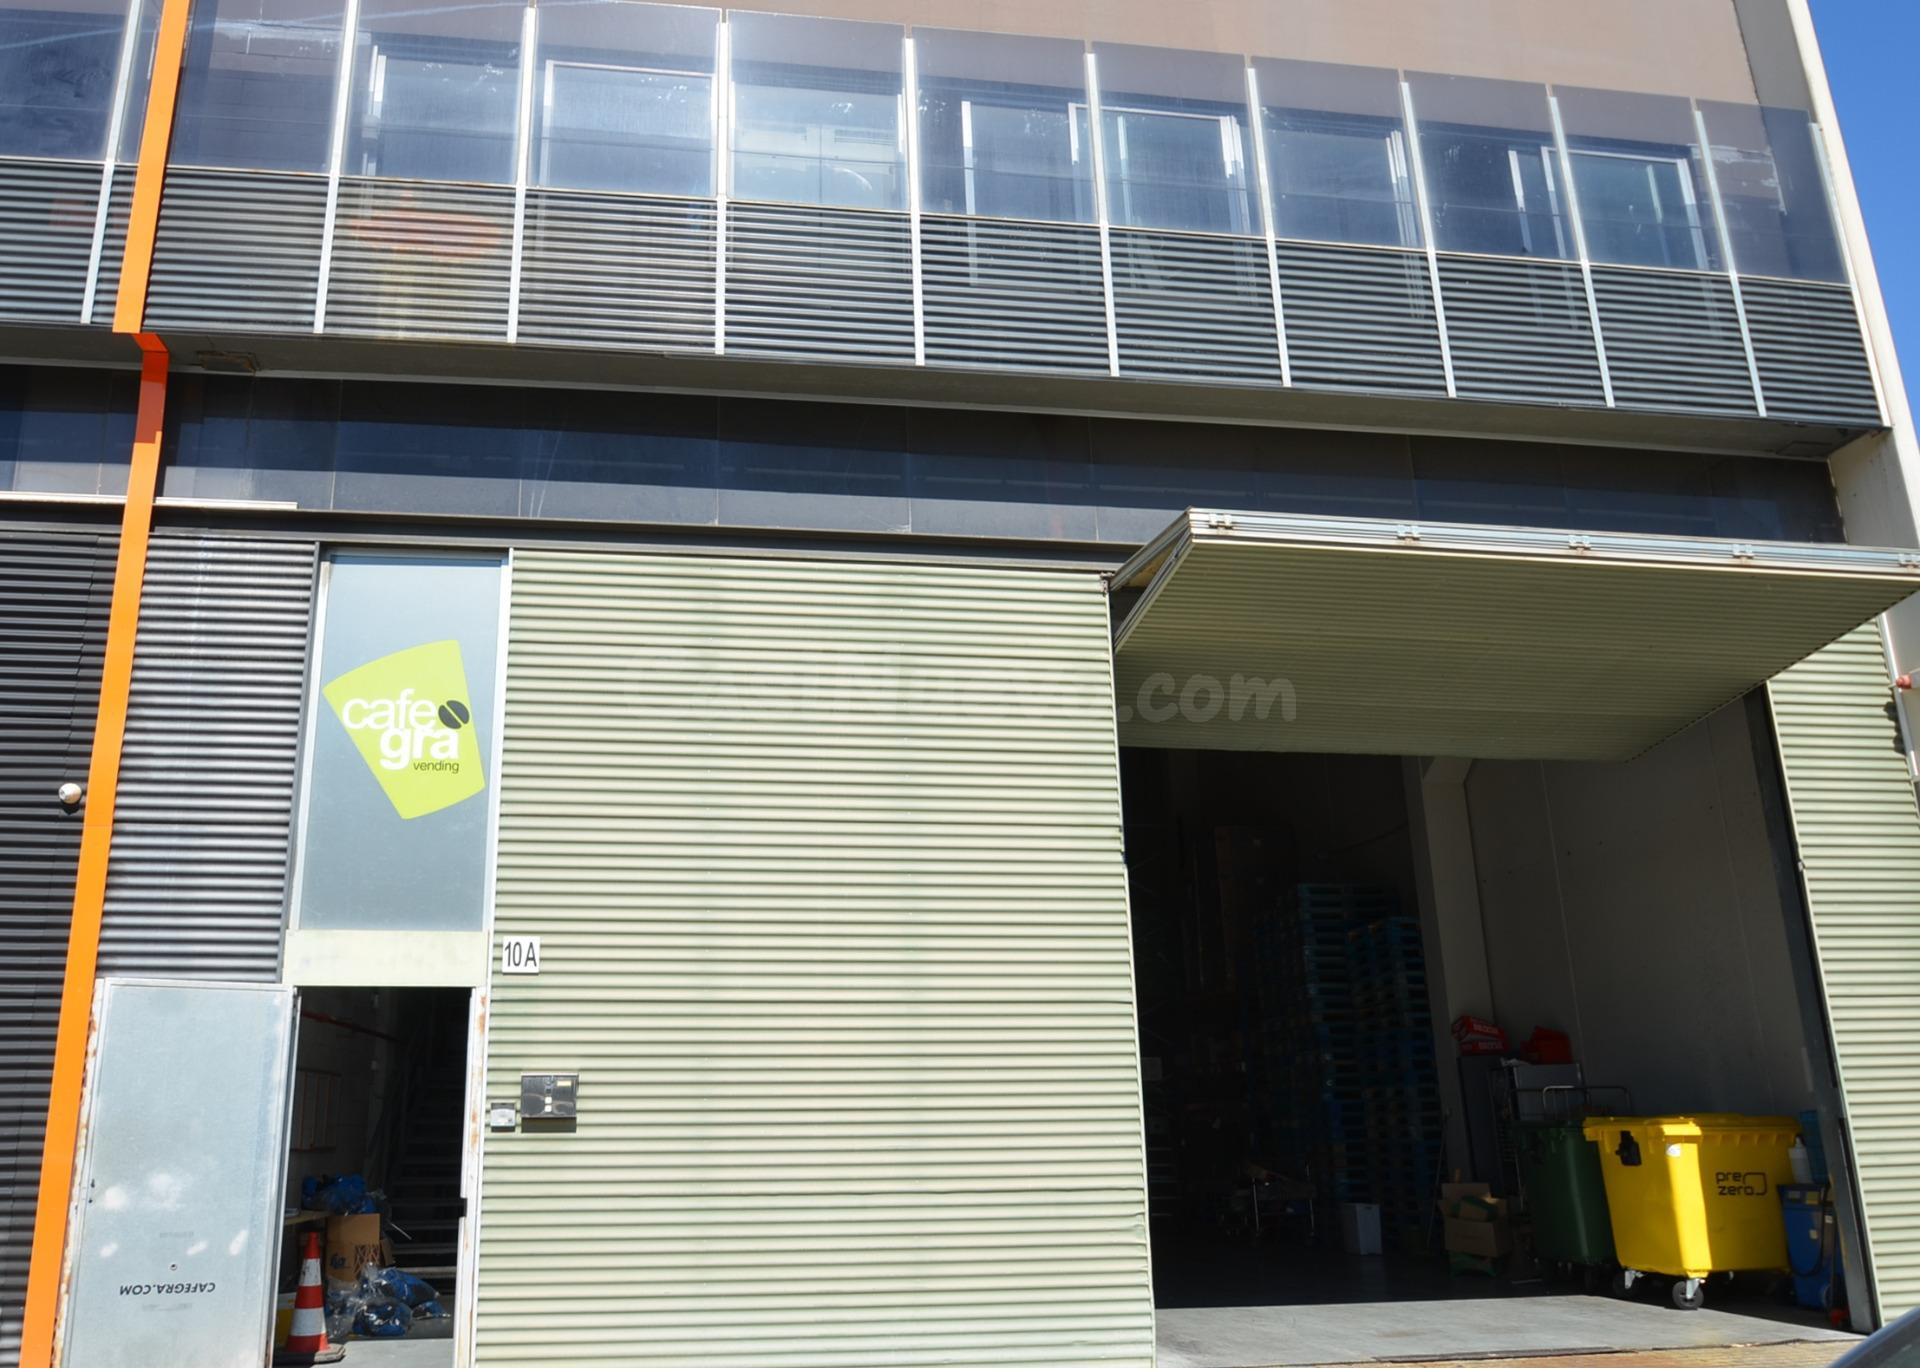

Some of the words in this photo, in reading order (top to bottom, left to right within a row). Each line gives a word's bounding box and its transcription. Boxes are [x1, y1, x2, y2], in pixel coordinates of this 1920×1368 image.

[342, 688, 437, 730] cafe
[379, 728, 459, 770] gra
[413, 760, 460, 774] vending
[504, 941, 521, 967] 10
[524, 941, 537, 967] A
[1715, 1171, 1742, 1184] pre
[1718, 1185, 1754, 1196] zero
[119, 1282, 216, 1296] CAFEGRA.COM
